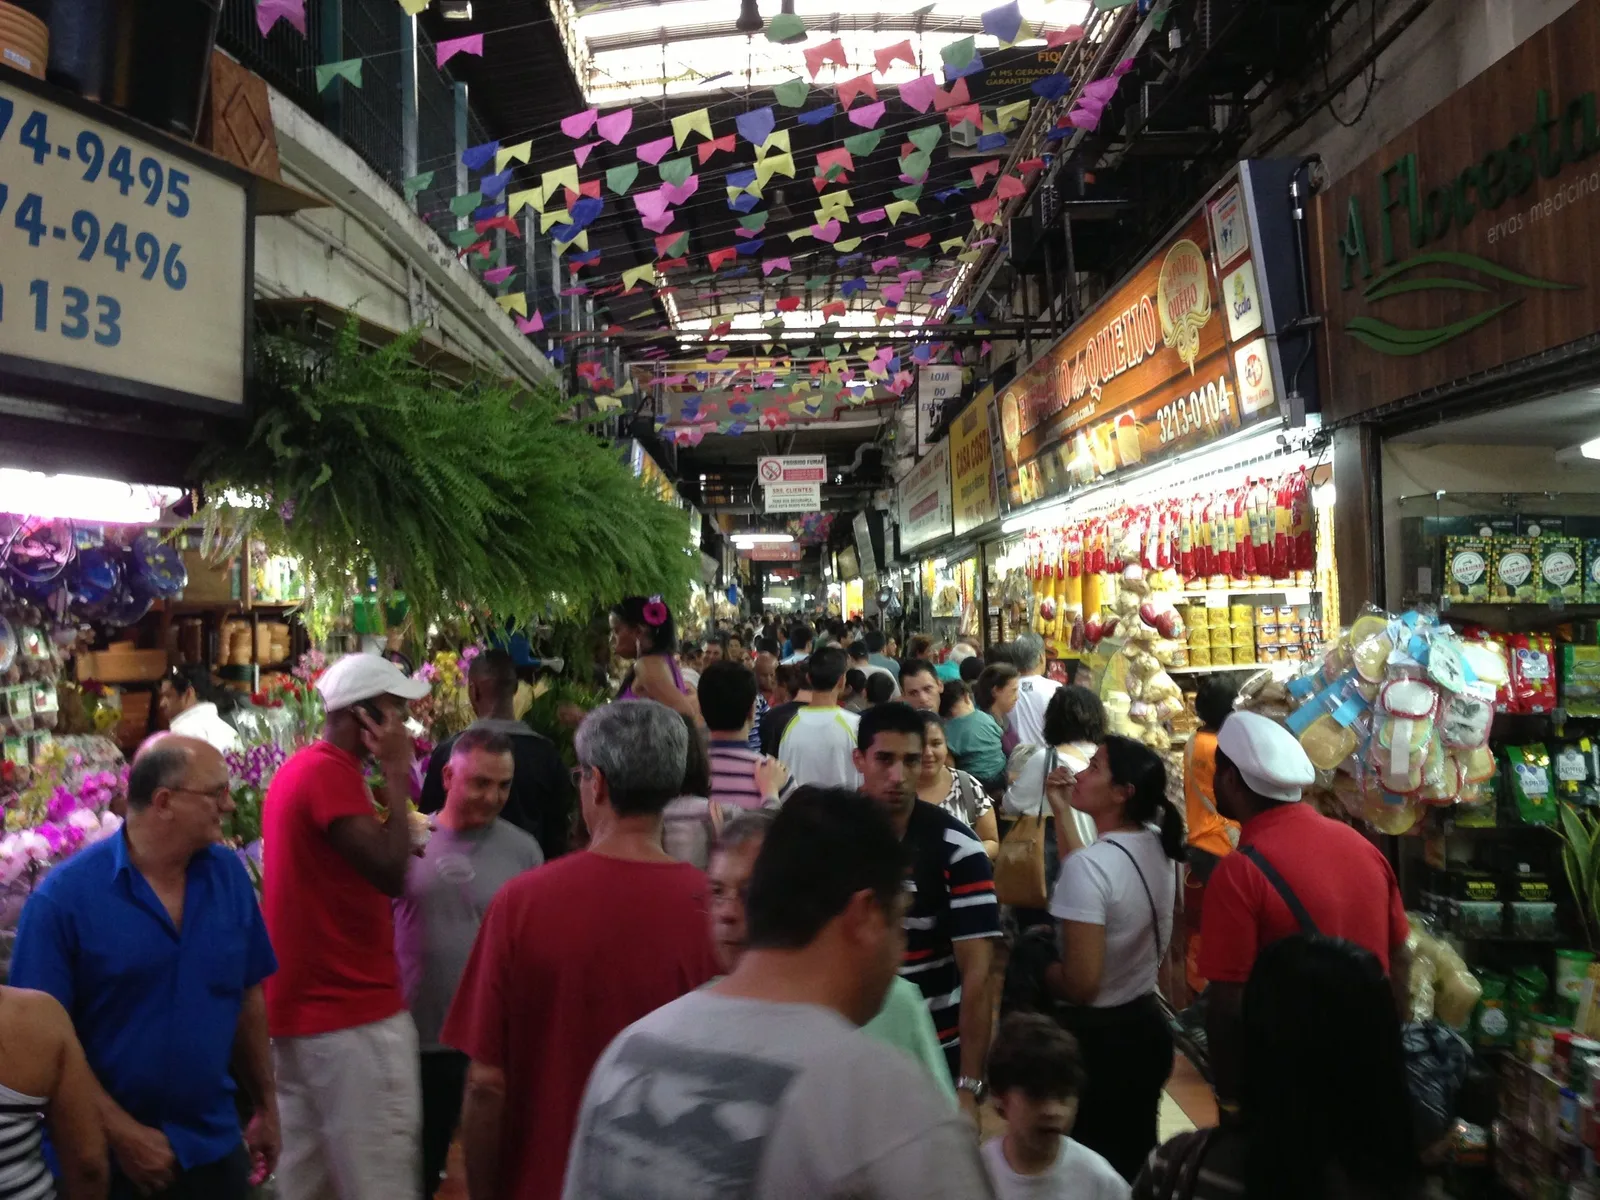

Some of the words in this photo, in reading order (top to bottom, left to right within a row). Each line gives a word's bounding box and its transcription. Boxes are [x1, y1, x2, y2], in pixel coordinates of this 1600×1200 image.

[1015, 67, 1054, 76] GERADO
[1339, 195, 1374, 292] A
[1380, 89, 1600, 267] Floresta
[1487, 212, 1524, 244] ervas
[29, 278, 122, 348] 133
[1085, 294, 1156, 401] QUEIJO
[930, 373, 950, 381] LOJA
[934, 388, 946, 396] DO
[1157, 375, 1234, 444] 3213-0104
